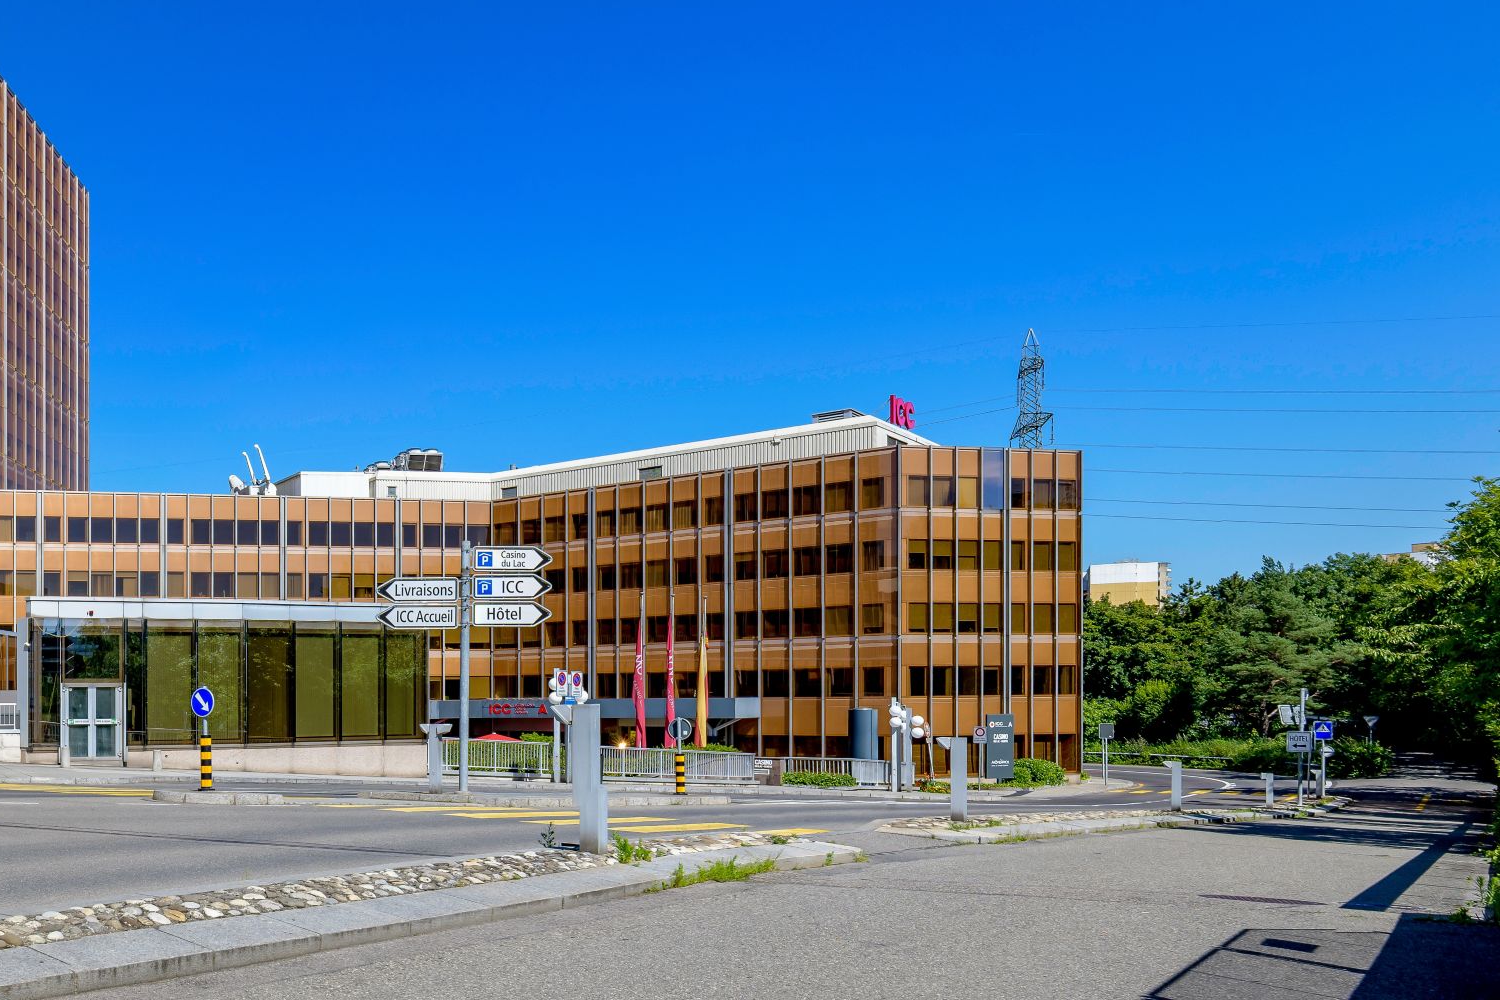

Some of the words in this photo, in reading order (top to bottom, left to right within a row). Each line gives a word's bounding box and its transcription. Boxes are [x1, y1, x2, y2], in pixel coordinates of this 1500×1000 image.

[889, 394, 916, 430] ICC
[500, 550, 526, 559] Casino
[501, 559, 511, 568] du
[512, 559, 526, 568] Lac
[394, 583, 453, 597] Livraisons
[501, 580, 524, 594] ICC
[396, 610, 414, 623] ICC
[415, 609, 453, 623] Accueil
[486, 606, 522, 621] Hôtel
[488, 703, 512, 715] ICC
[537, 703, 548, 715] A
